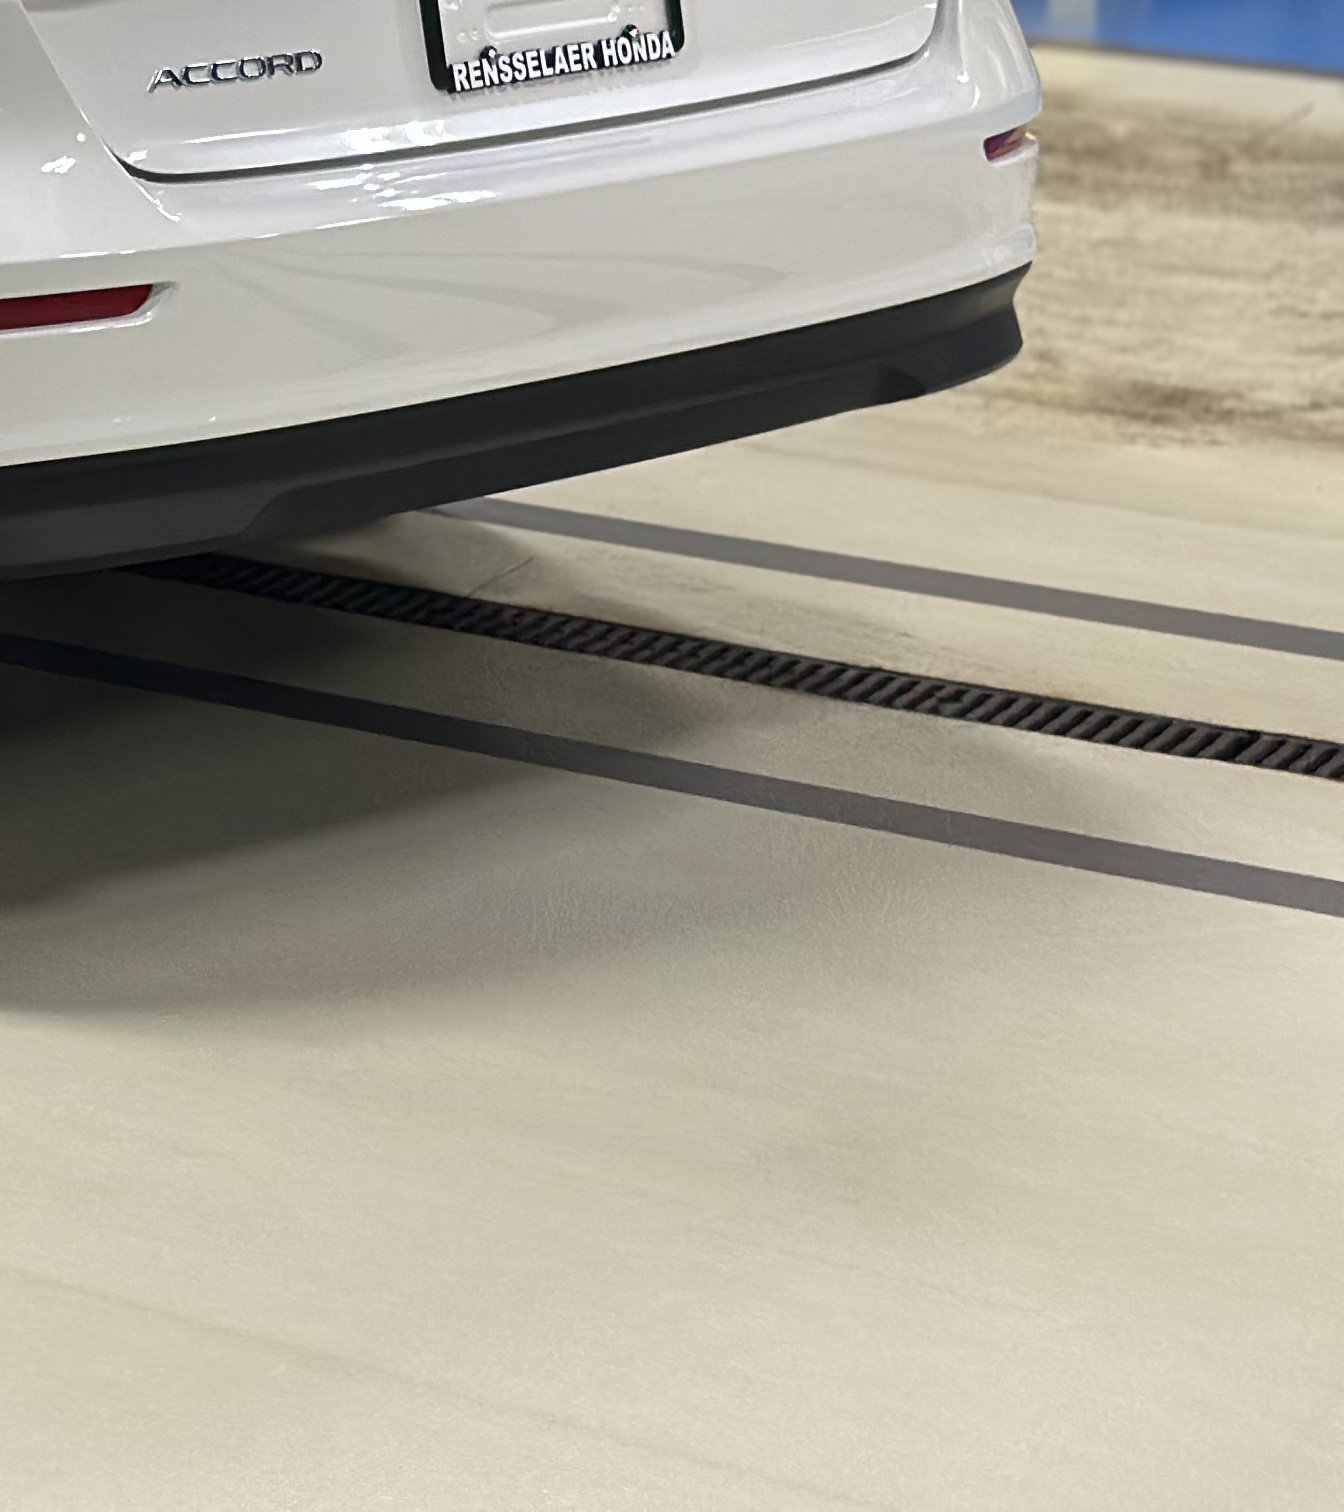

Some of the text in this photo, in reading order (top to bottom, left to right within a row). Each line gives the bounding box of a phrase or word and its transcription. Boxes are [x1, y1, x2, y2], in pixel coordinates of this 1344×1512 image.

[147, 48, 323, 93] ACCORD
[453, 30, 676, 92] RENSSELAER HONDA
